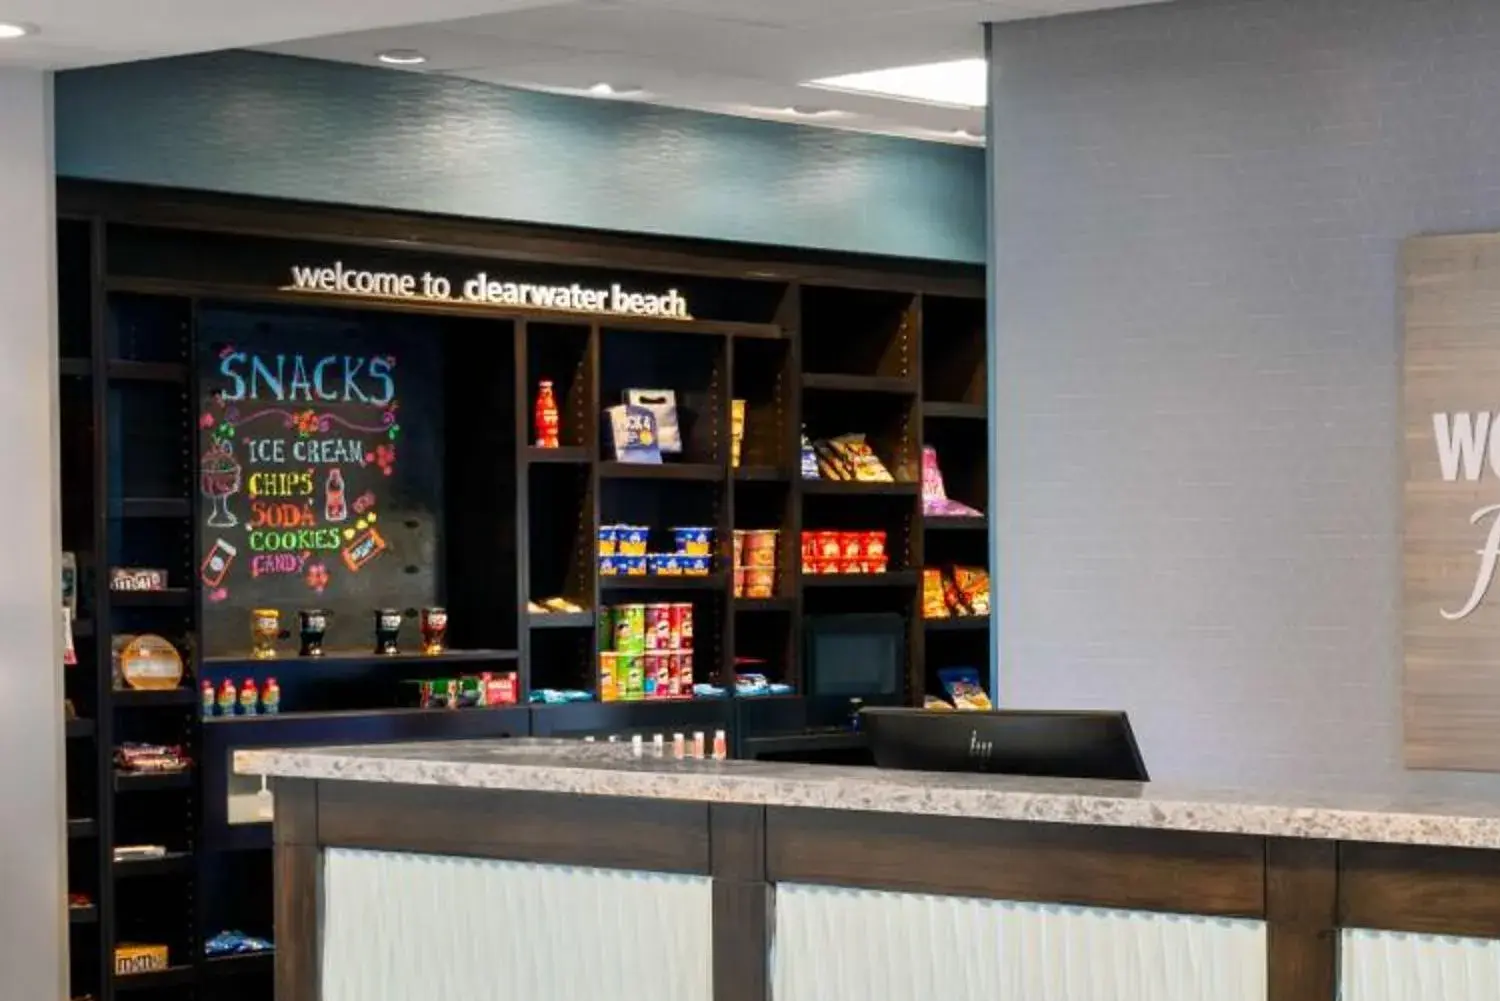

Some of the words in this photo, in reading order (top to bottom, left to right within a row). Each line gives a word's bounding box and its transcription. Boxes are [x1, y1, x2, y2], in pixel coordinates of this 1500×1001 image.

[292, 261, 415, 297] welcome
[421, 271, 451, 299] to
[463, 272, 608, 310] clearwater
[611, 283, 687, 317] beach
[219, 351, 395, 405] SNACKS
[249, 439, 285, 464] ICE
[293, 438, 365, 464] CREAM
[249, 472, 313, 496] CHIPS
[250, 502, 316, 528] SODA
[249, 528, 341, 550] COOKIES
[251, 553, 305, 577] CANDY
